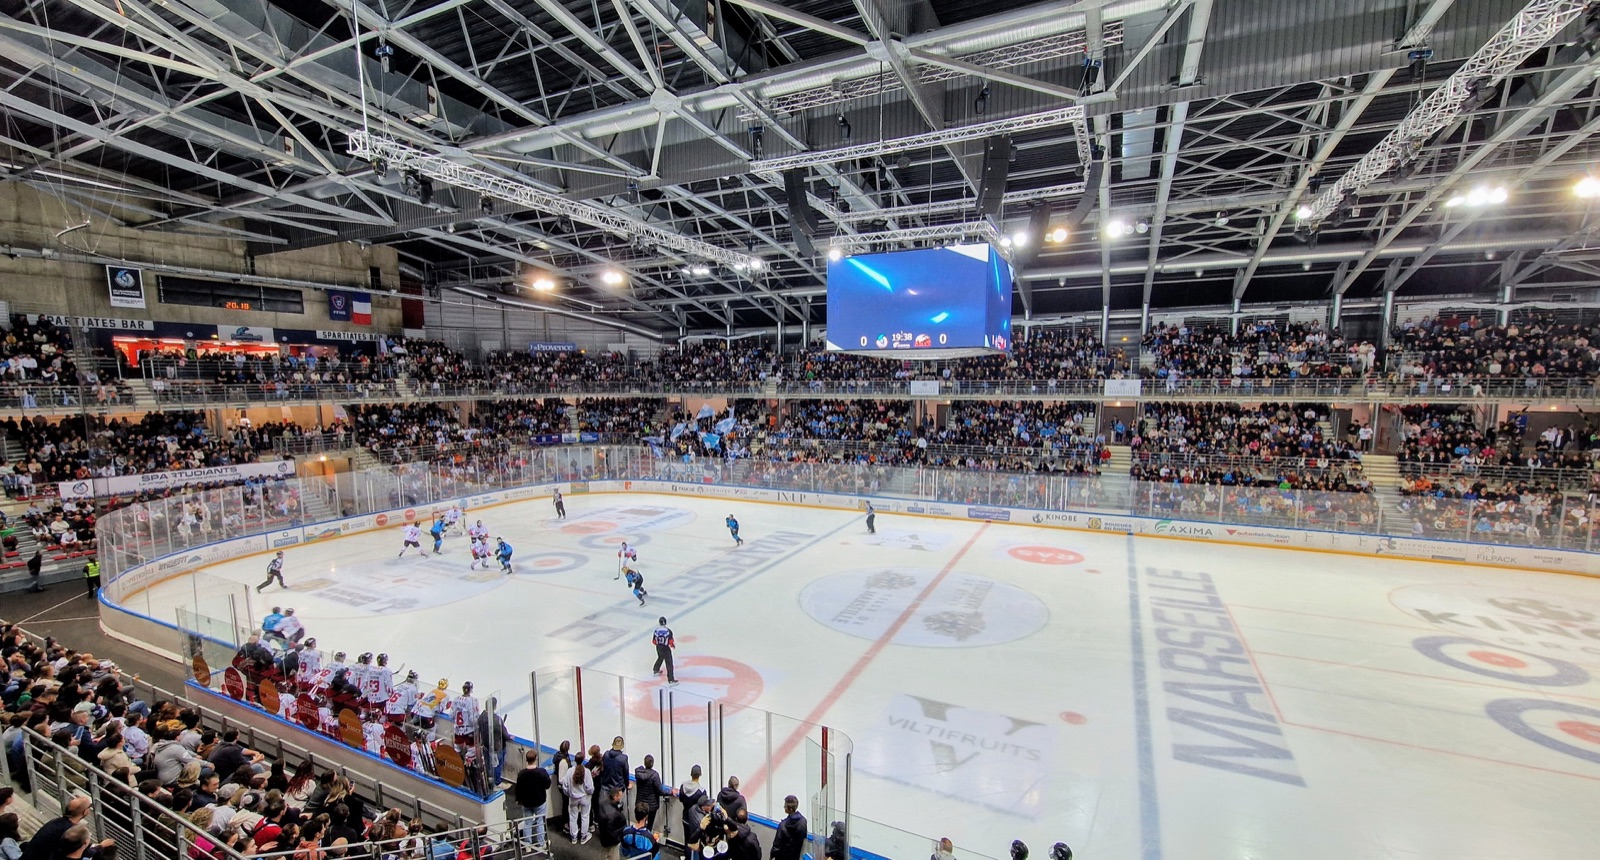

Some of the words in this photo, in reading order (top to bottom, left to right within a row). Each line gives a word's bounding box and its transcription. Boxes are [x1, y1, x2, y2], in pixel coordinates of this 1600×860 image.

[122, 320, 145, 330] BAR
[322, 331, 367, 341] SPARTIATES
[860, 335, 868, 347] 0
[939, 333, 947, 345] 0
[1169, 525, 1213, 536] AXIMA
[1237, 531, 1290, 540] autodistribution
[1476, 554, 1517, 564] FILPACK
[1146, 567, 1308, 788] MARSEILLE
[392, 733, 402, 743] LES
[888, 715, 1042, 762] VILTIFRUITS
